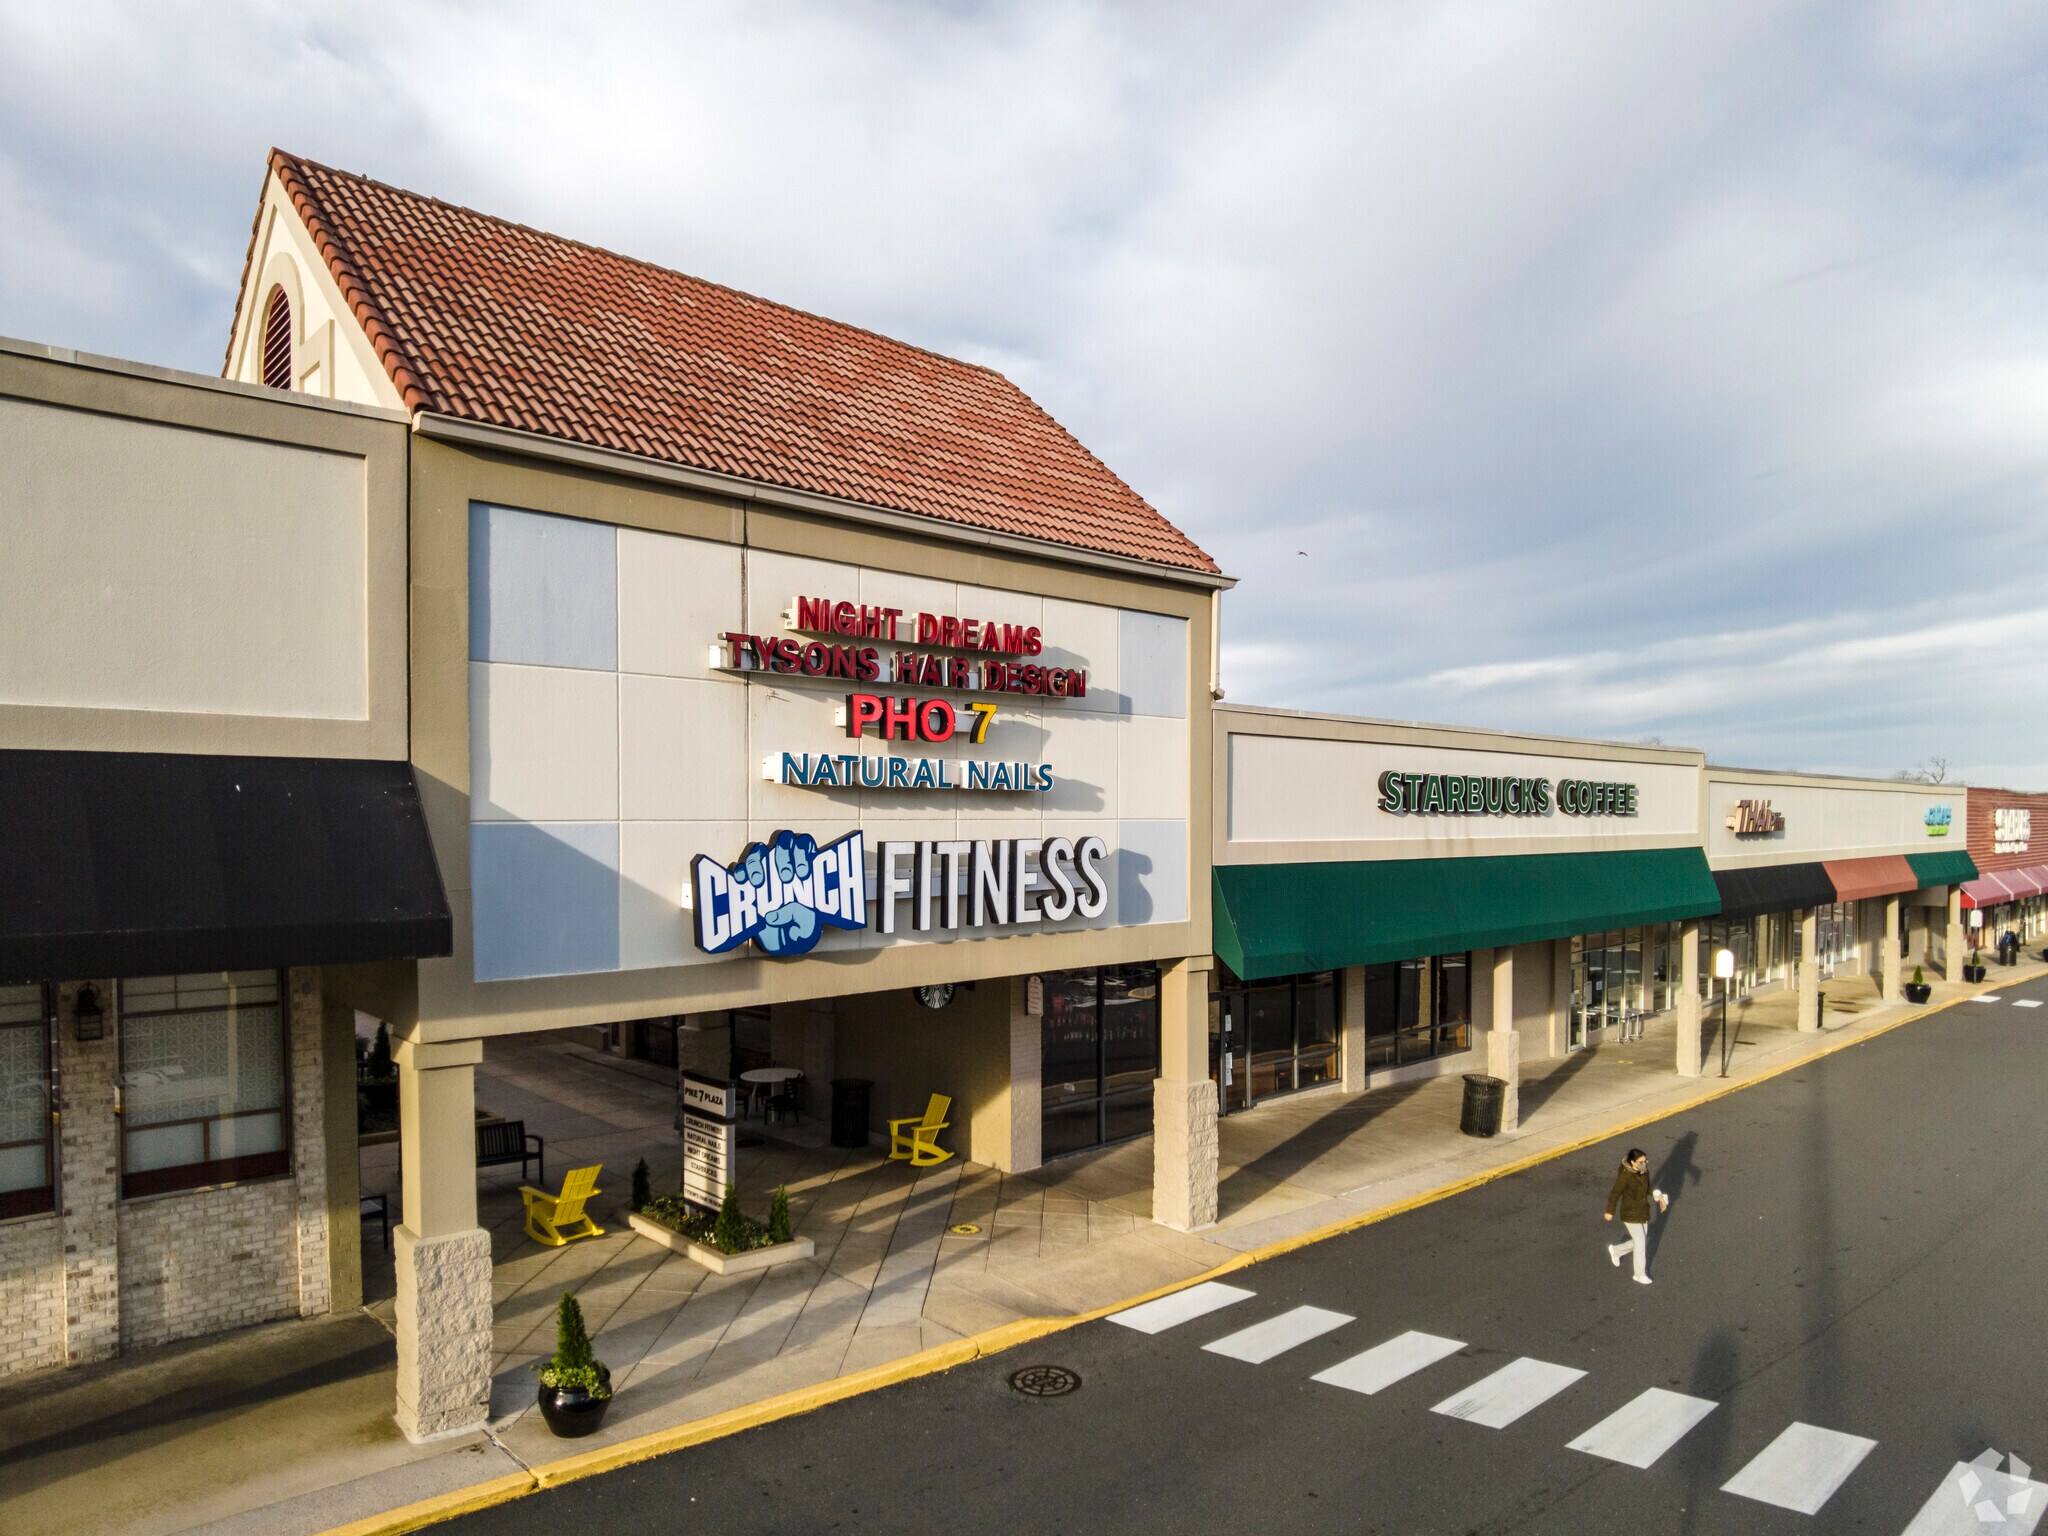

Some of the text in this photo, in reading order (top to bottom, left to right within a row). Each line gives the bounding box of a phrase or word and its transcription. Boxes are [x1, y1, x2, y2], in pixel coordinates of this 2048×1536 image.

[797, 595, 1042, 657] NIGHT DREAMS
[724, 632, 881, 681] TYSONS
[984, 660, 1086, 697] DESIGN
[849, 693, 998, 744] PHO 7
[781, 752, 1054, 792] NATURAL NAILS
[1384, 770, 1637, 814] STARBUCKS COFFEE
[697, 832, 1108, 952] CRUNCH FITNESS
[685, 1087, 723, 1106] PIKE 7 PLAZA
